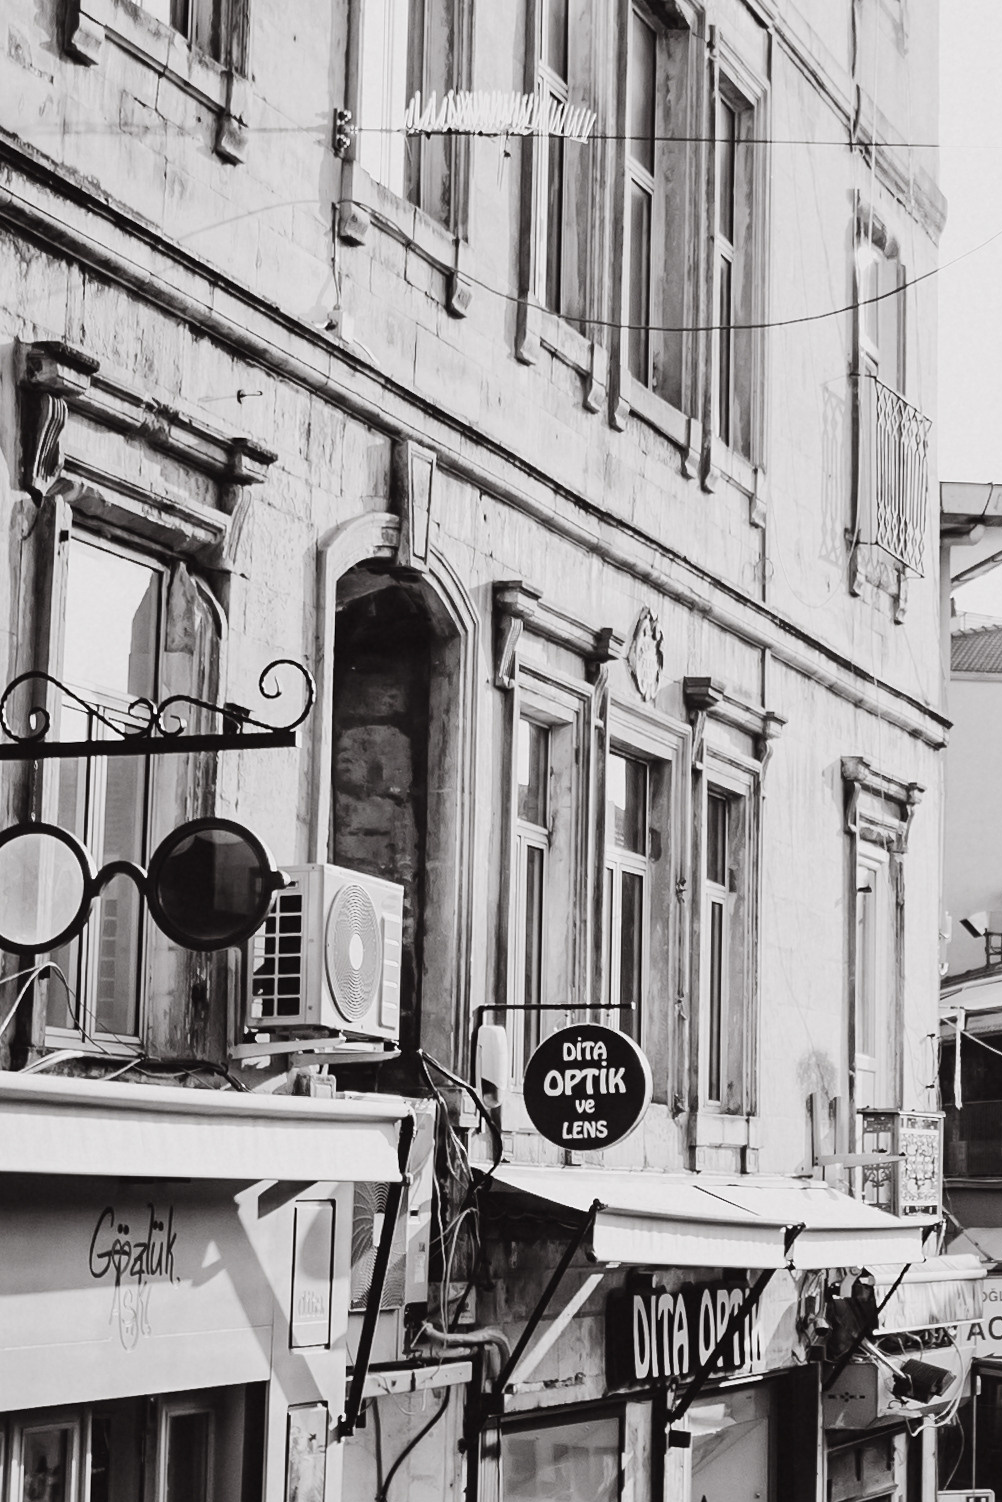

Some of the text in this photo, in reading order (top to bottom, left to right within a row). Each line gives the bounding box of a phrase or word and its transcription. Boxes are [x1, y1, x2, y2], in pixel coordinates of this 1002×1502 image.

[563, 1037, 607, 1061] DİTA
[543, 1061, 627, 1097] OPTİK
[575, 1098, 596, 1114] ve
[562, 1120, 608, 1139] LENS
[633, 1292, 689, 1379] DITA
